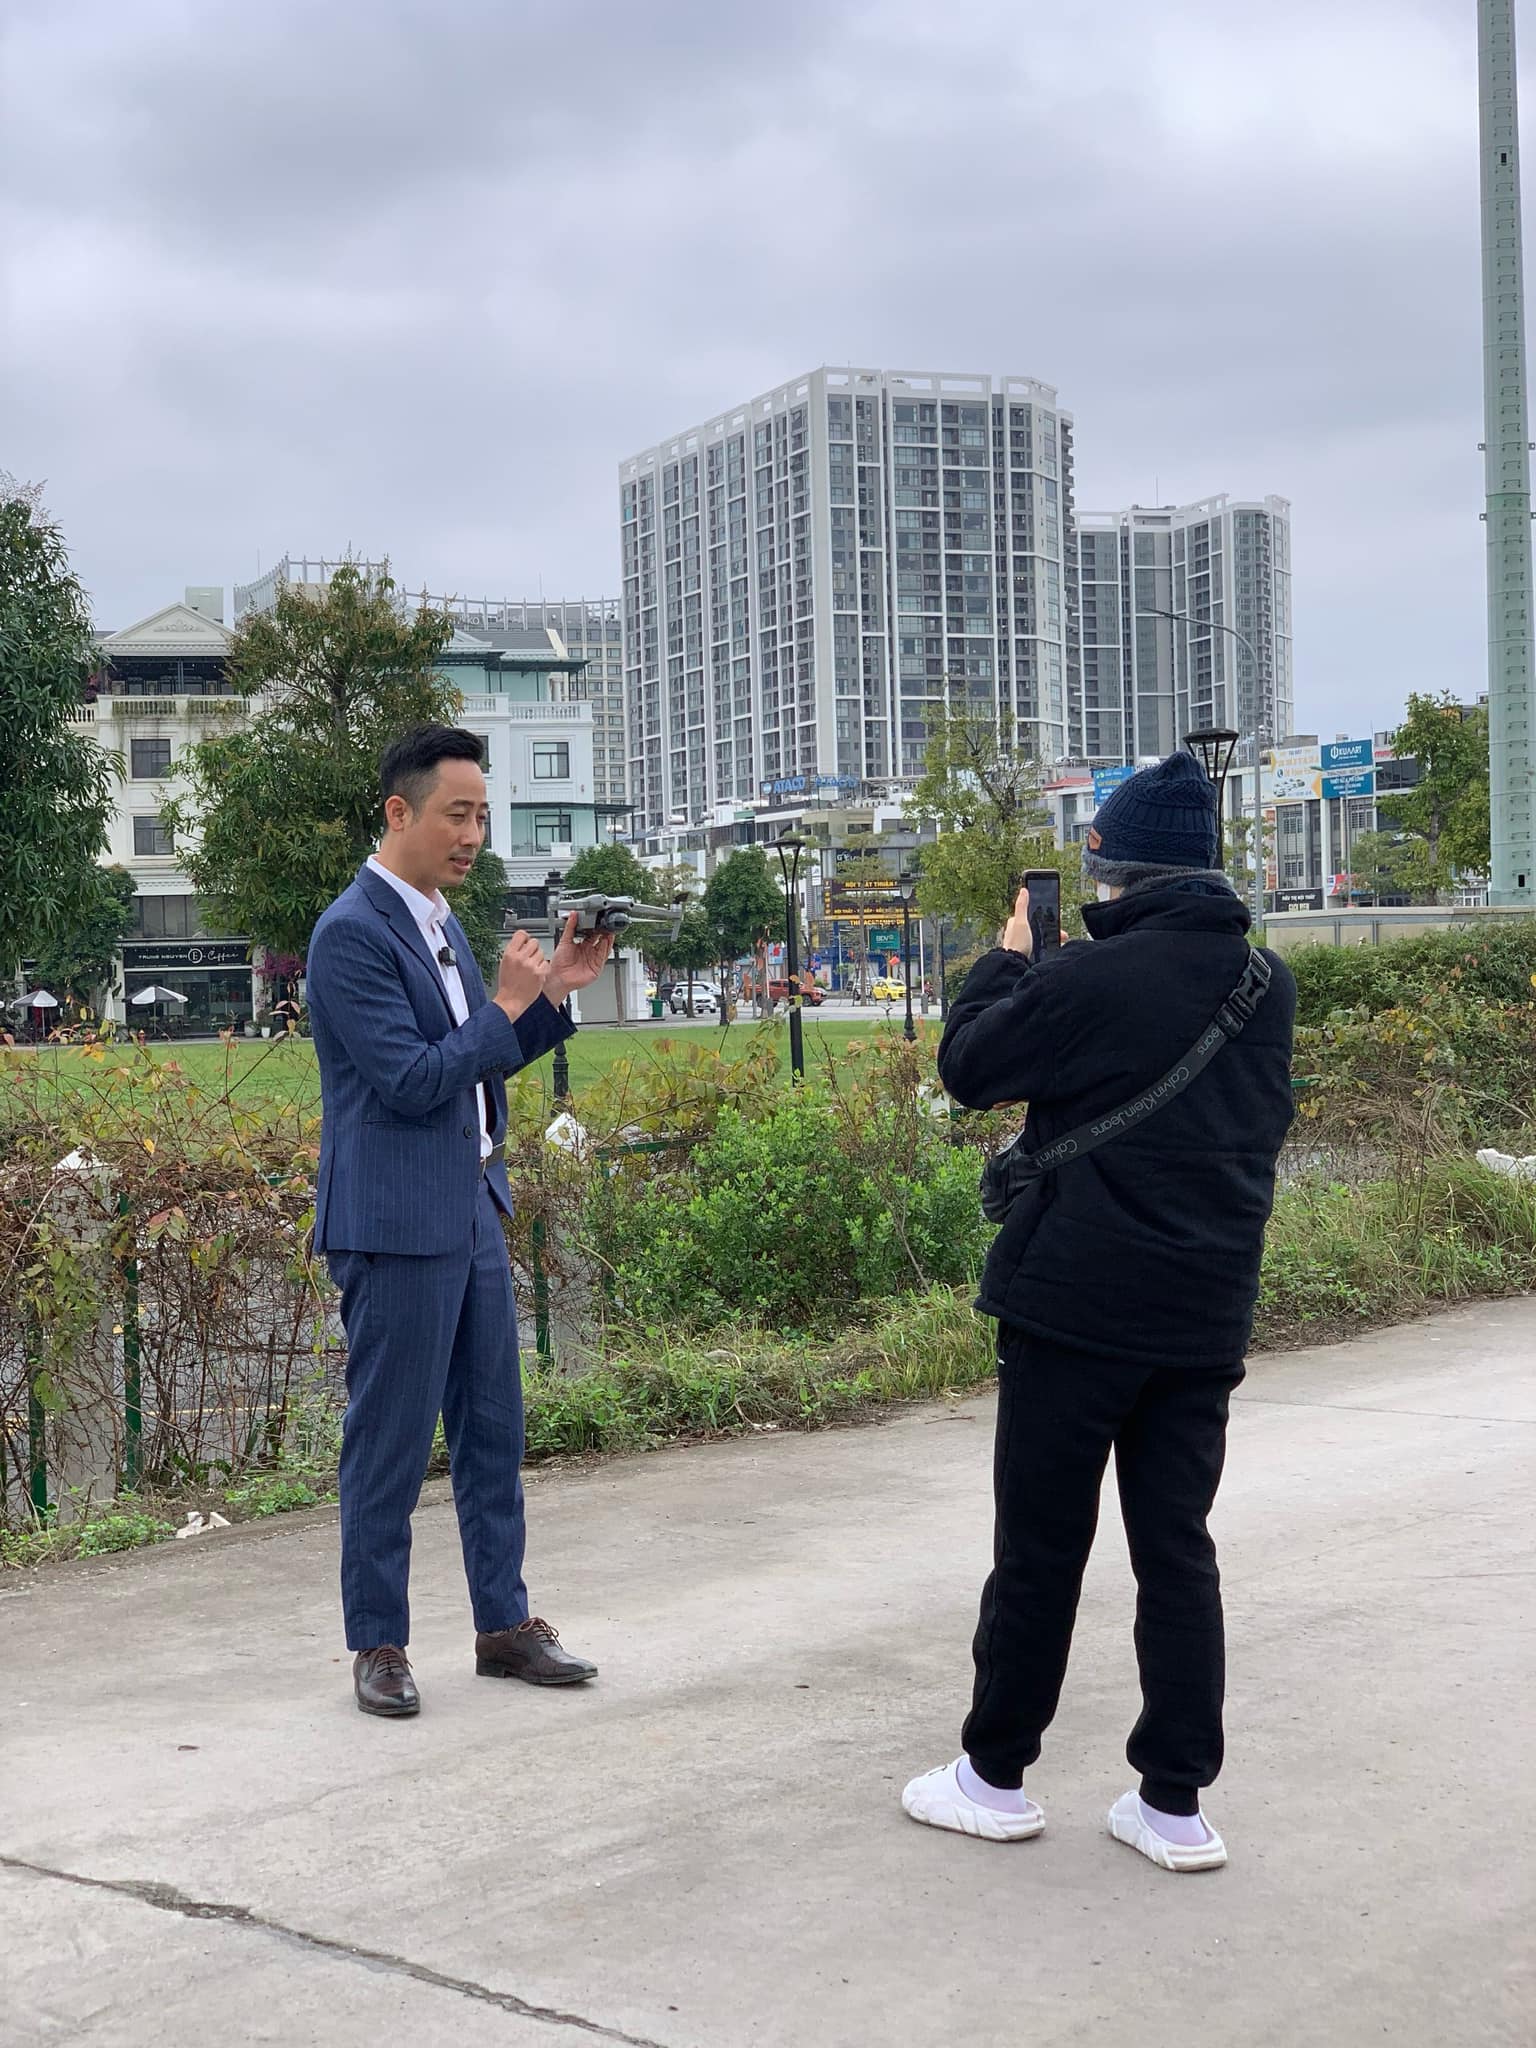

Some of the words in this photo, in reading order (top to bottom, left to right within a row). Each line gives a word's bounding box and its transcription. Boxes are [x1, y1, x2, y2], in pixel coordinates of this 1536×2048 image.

[773, 776, 806, 794] ATACO
[1153, 1066, 1190, 1098] Calvin
[1040, 1139, 1078, 1163] Calvin
